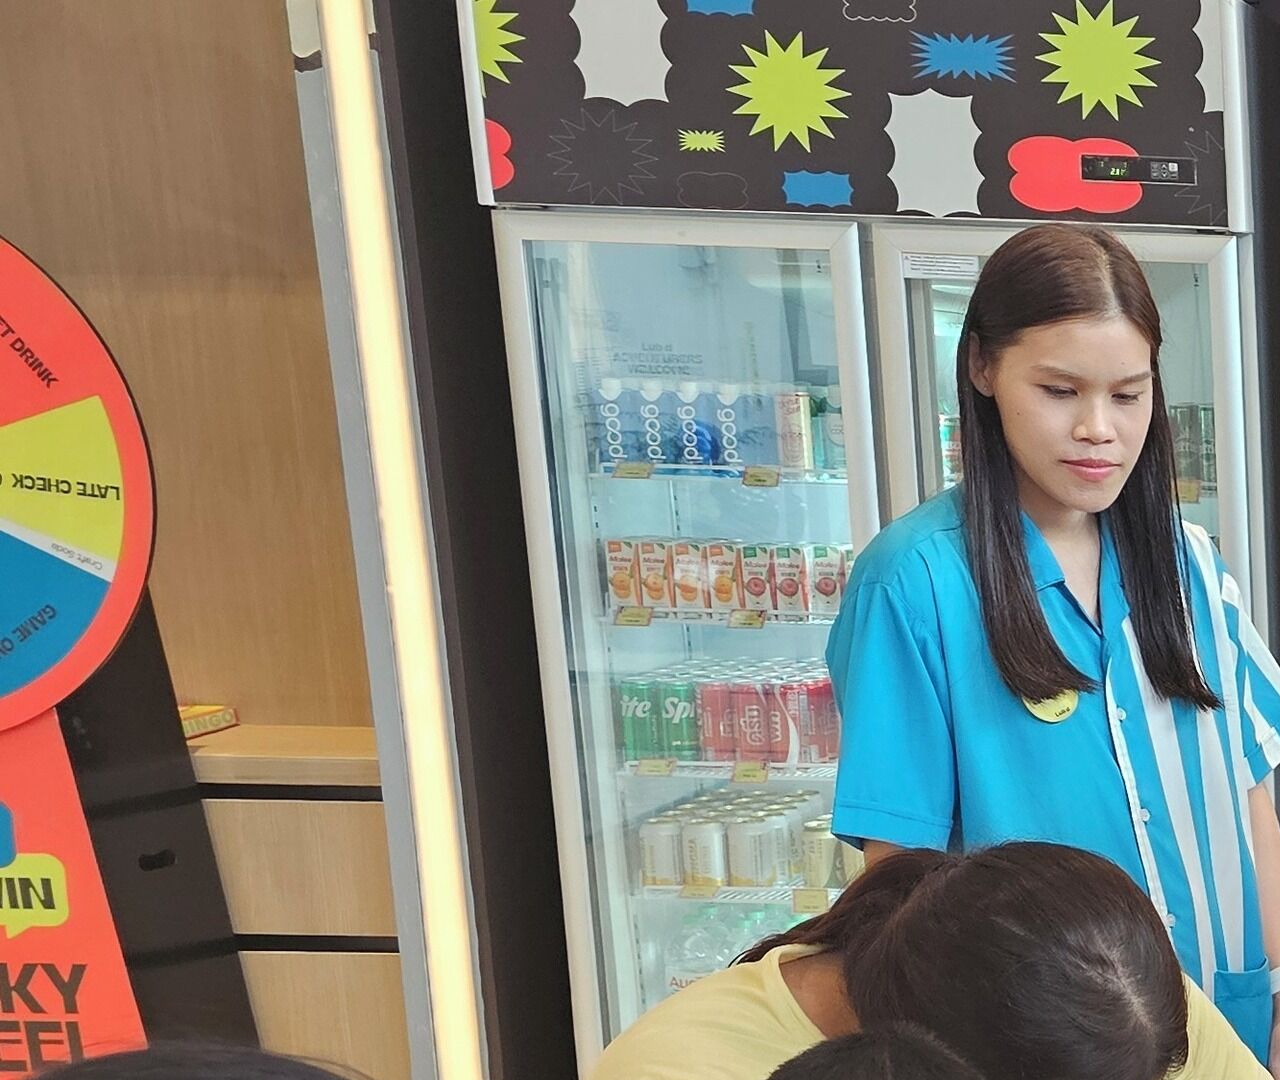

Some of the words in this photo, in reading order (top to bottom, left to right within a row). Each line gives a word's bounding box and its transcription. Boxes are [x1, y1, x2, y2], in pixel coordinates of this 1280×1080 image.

[10, 337, 59, 388] DRINK
[11, 473, 72, 494] CHECK
[76, 481, 120, 500] LATE
[18, 604, 57, 643] GAME
[0, 877, 56, 910] IN
